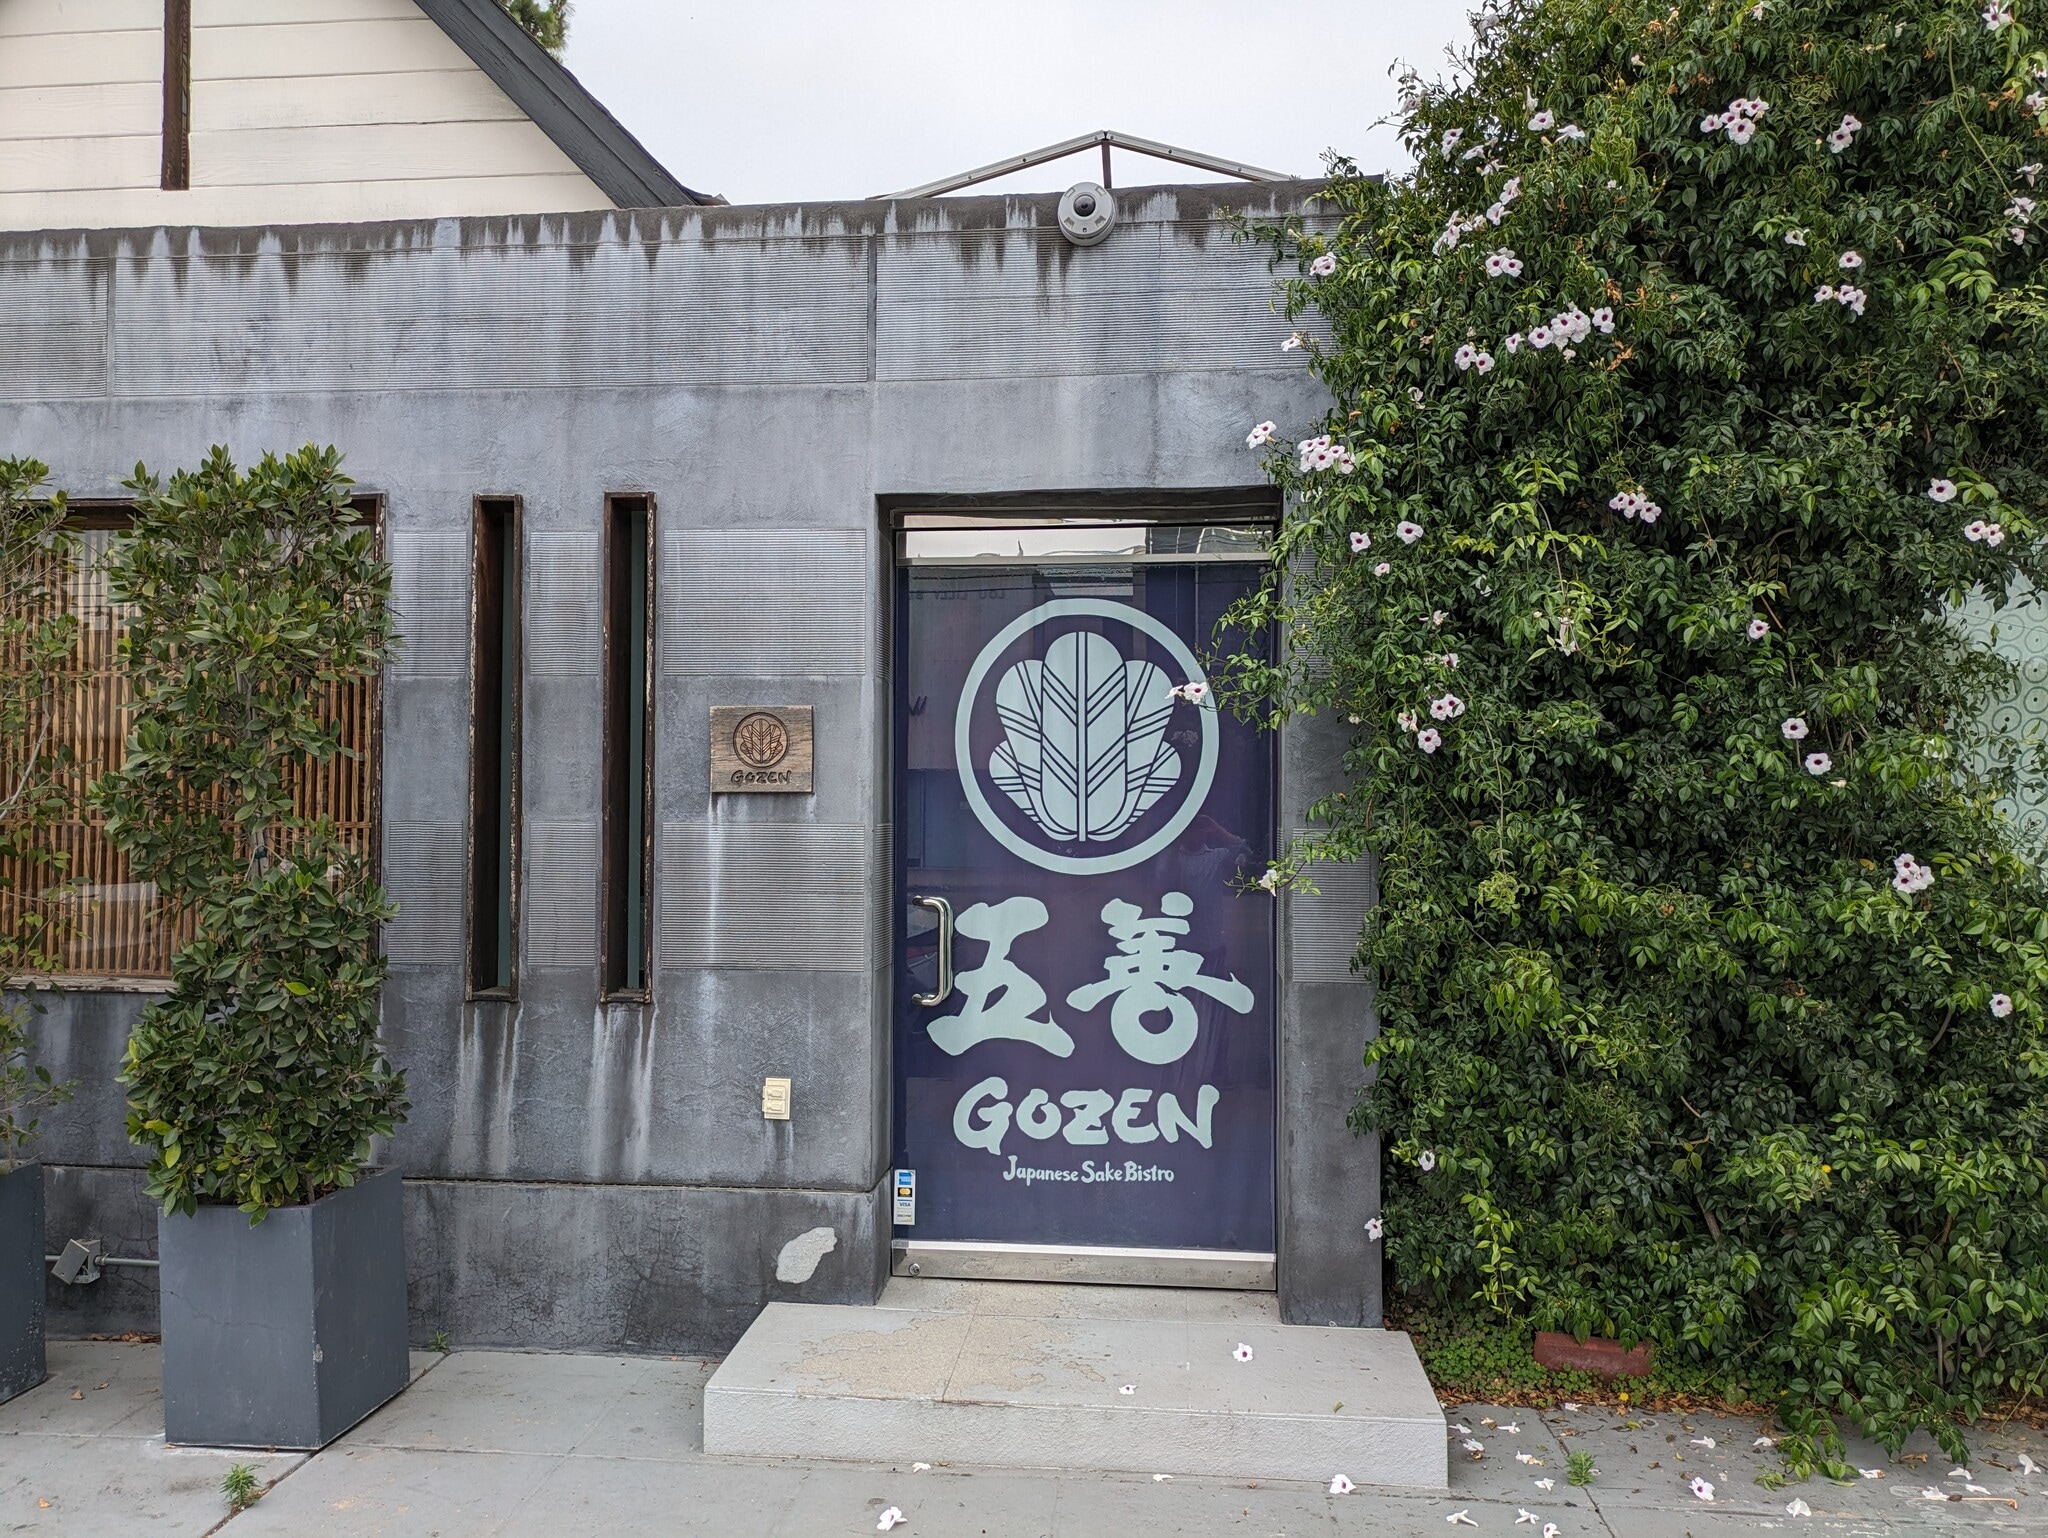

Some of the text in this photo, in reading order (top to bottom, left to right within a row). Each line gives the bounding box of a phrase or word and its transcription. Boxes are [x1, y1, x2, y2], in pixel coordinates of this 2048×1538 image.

[730, 769, 792, 787] GOZEN
[926, 891, 1255, 1065] 五善
[953, 1076, 1220, 1156] GOZEN
[1002, 1154, 1175, 1187] Japanese Sake Bistro
